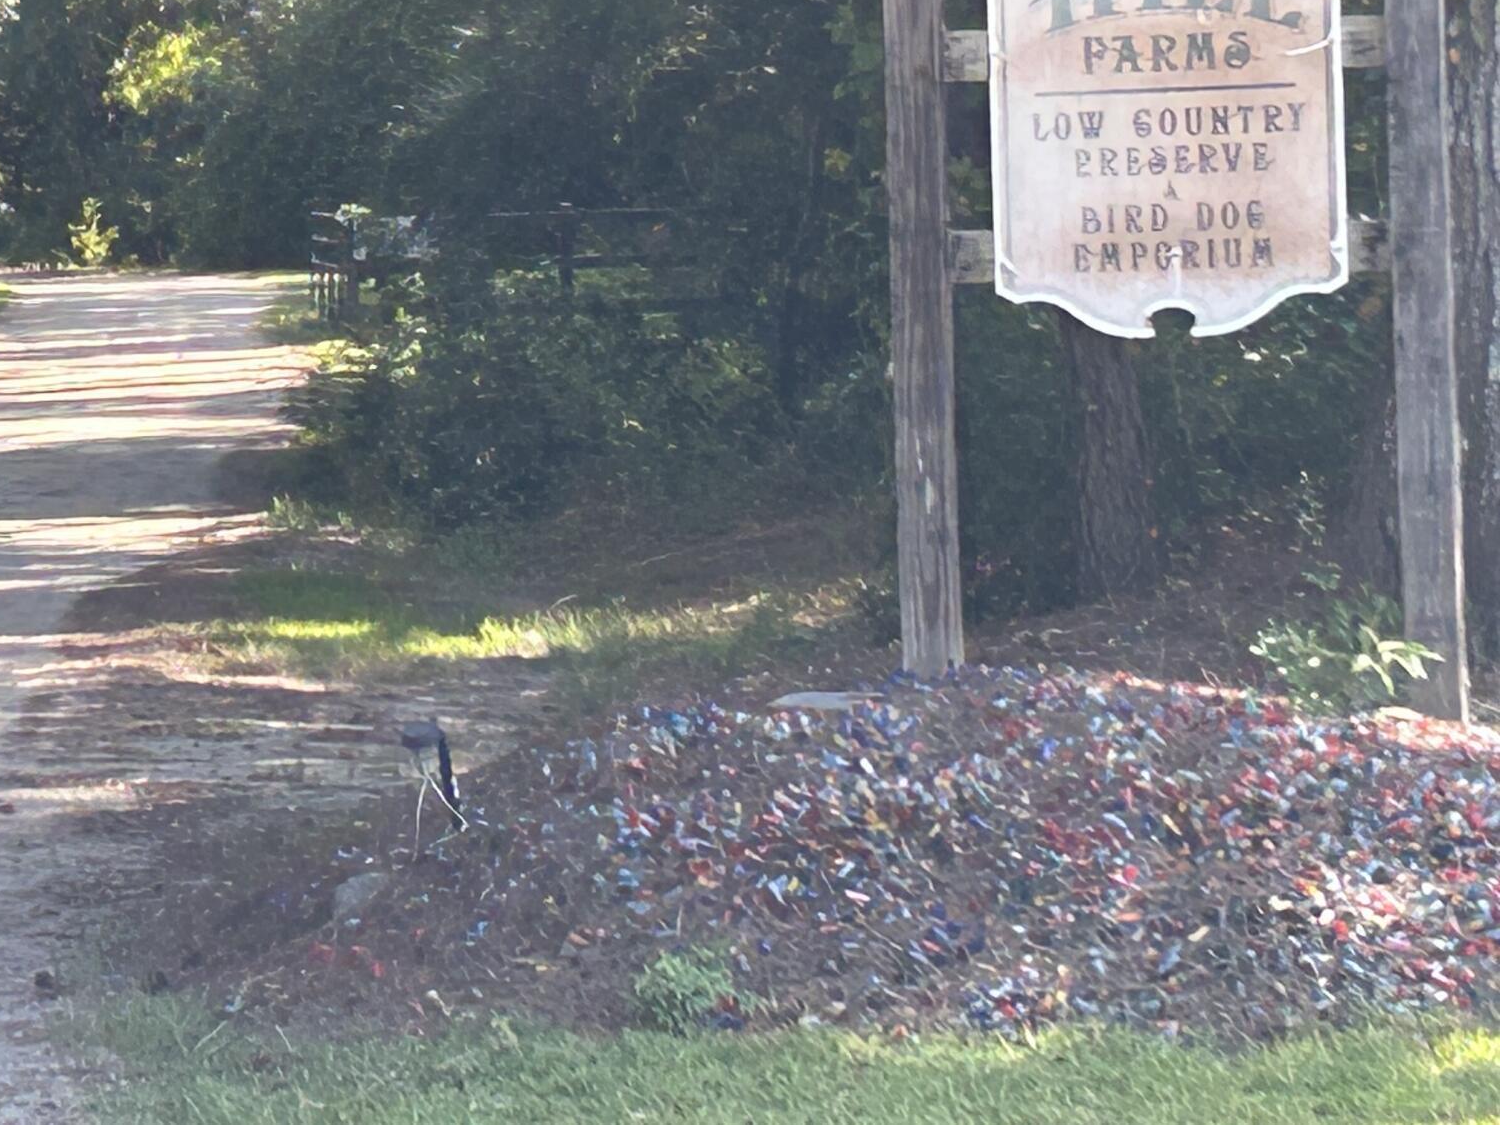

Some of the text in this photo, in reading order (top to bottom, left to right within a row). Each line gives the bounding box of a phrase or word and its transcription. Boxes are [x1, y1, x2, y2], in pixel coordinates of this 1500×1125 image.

[1082, 31, 1257, 74] FARMS
[1033, 102, 1307, 141] LOW COUNTRY
[1075, 142, 1275, 178] PRESERVE
[1081, 199, 1266, 235] BIRD DOG
[1073, 237, 1276, 274] EMPORIUM
